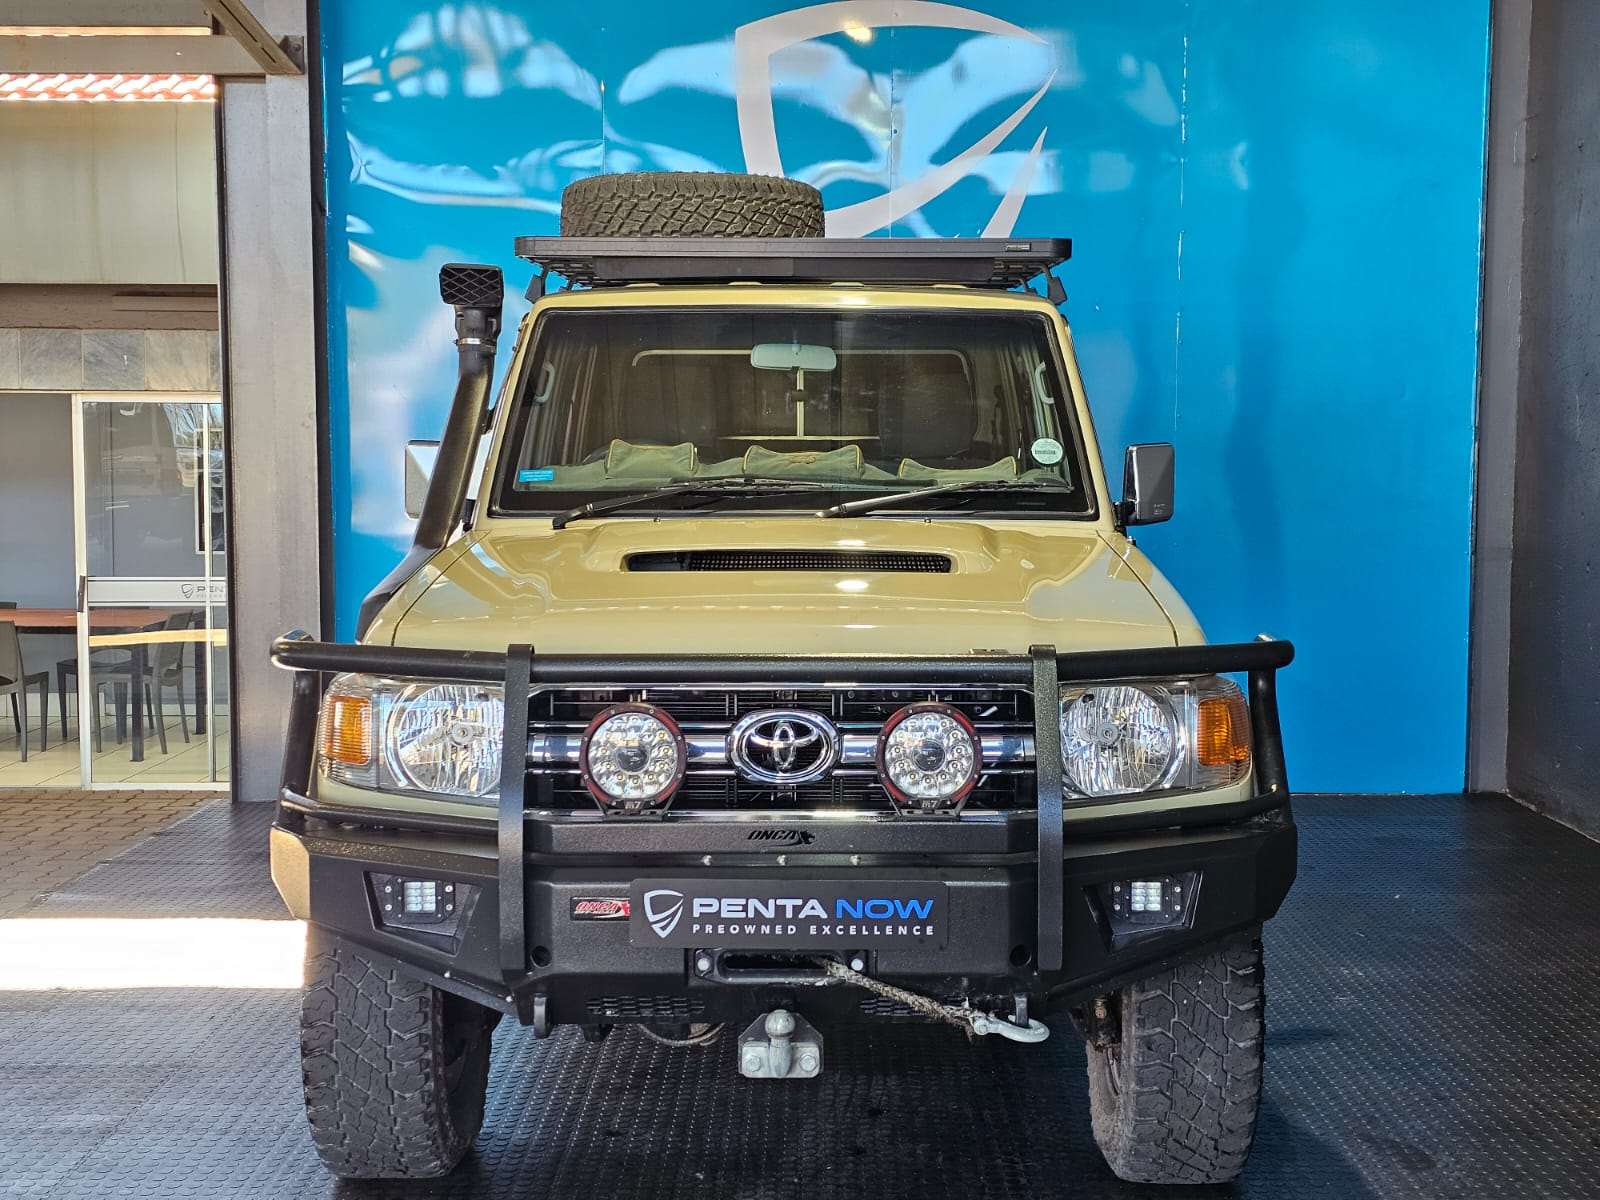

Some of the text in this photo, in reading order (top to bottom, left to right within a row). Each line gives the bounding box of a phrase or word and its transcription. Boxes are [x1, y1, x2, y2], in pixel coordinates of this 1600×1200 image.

[692, 898, 934, 919] PENTA NOW
[692, 924, 935, 936] PREOWNED EXCELLENCE
